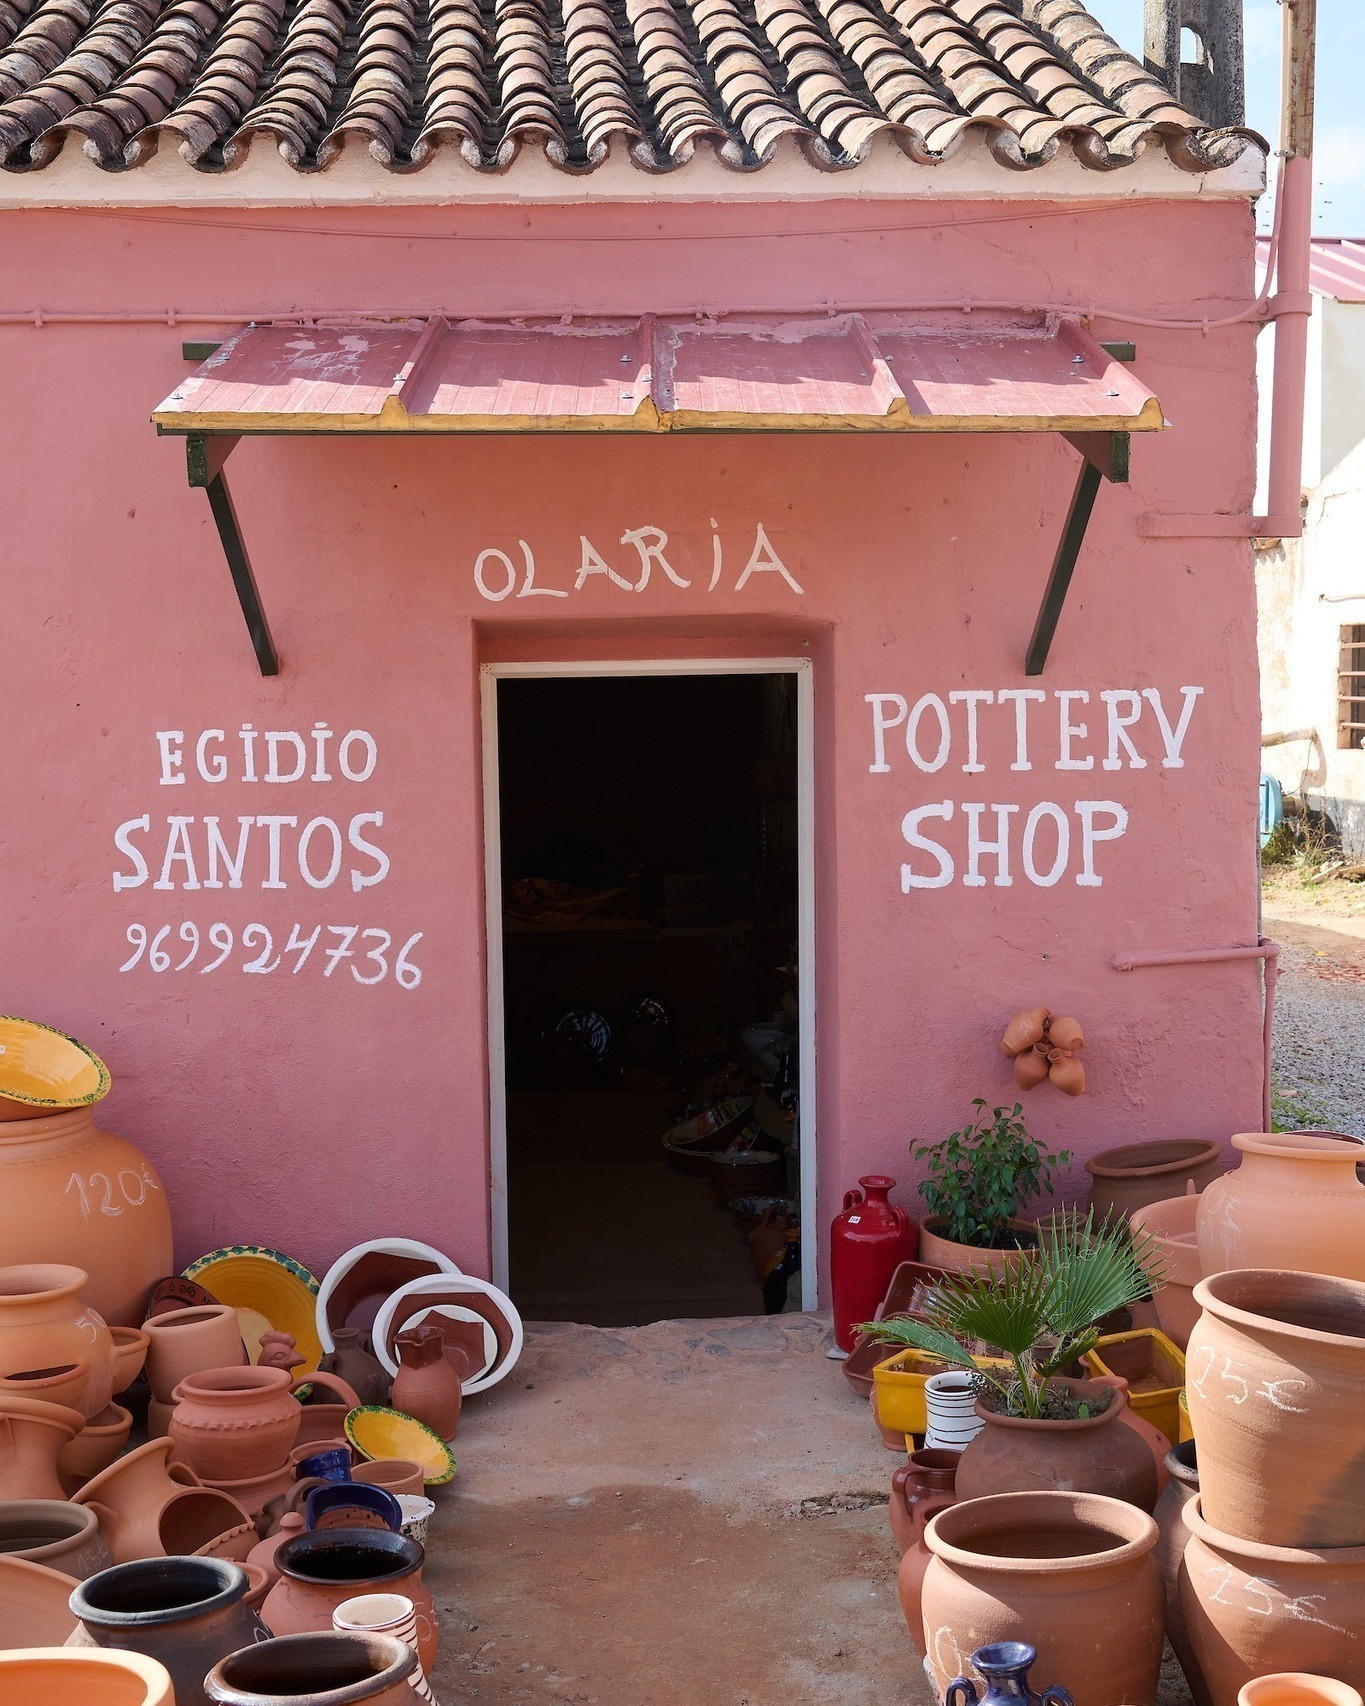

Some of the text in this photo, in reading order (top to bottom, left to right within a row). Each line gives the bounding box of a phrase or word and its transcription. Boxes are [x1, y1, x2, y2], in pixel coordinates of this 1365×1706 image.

[113, 811, 391, 892] SANTOS
[900, 800, 1129, 894] SHOP
[119, 921, 423, 990] 969924736
